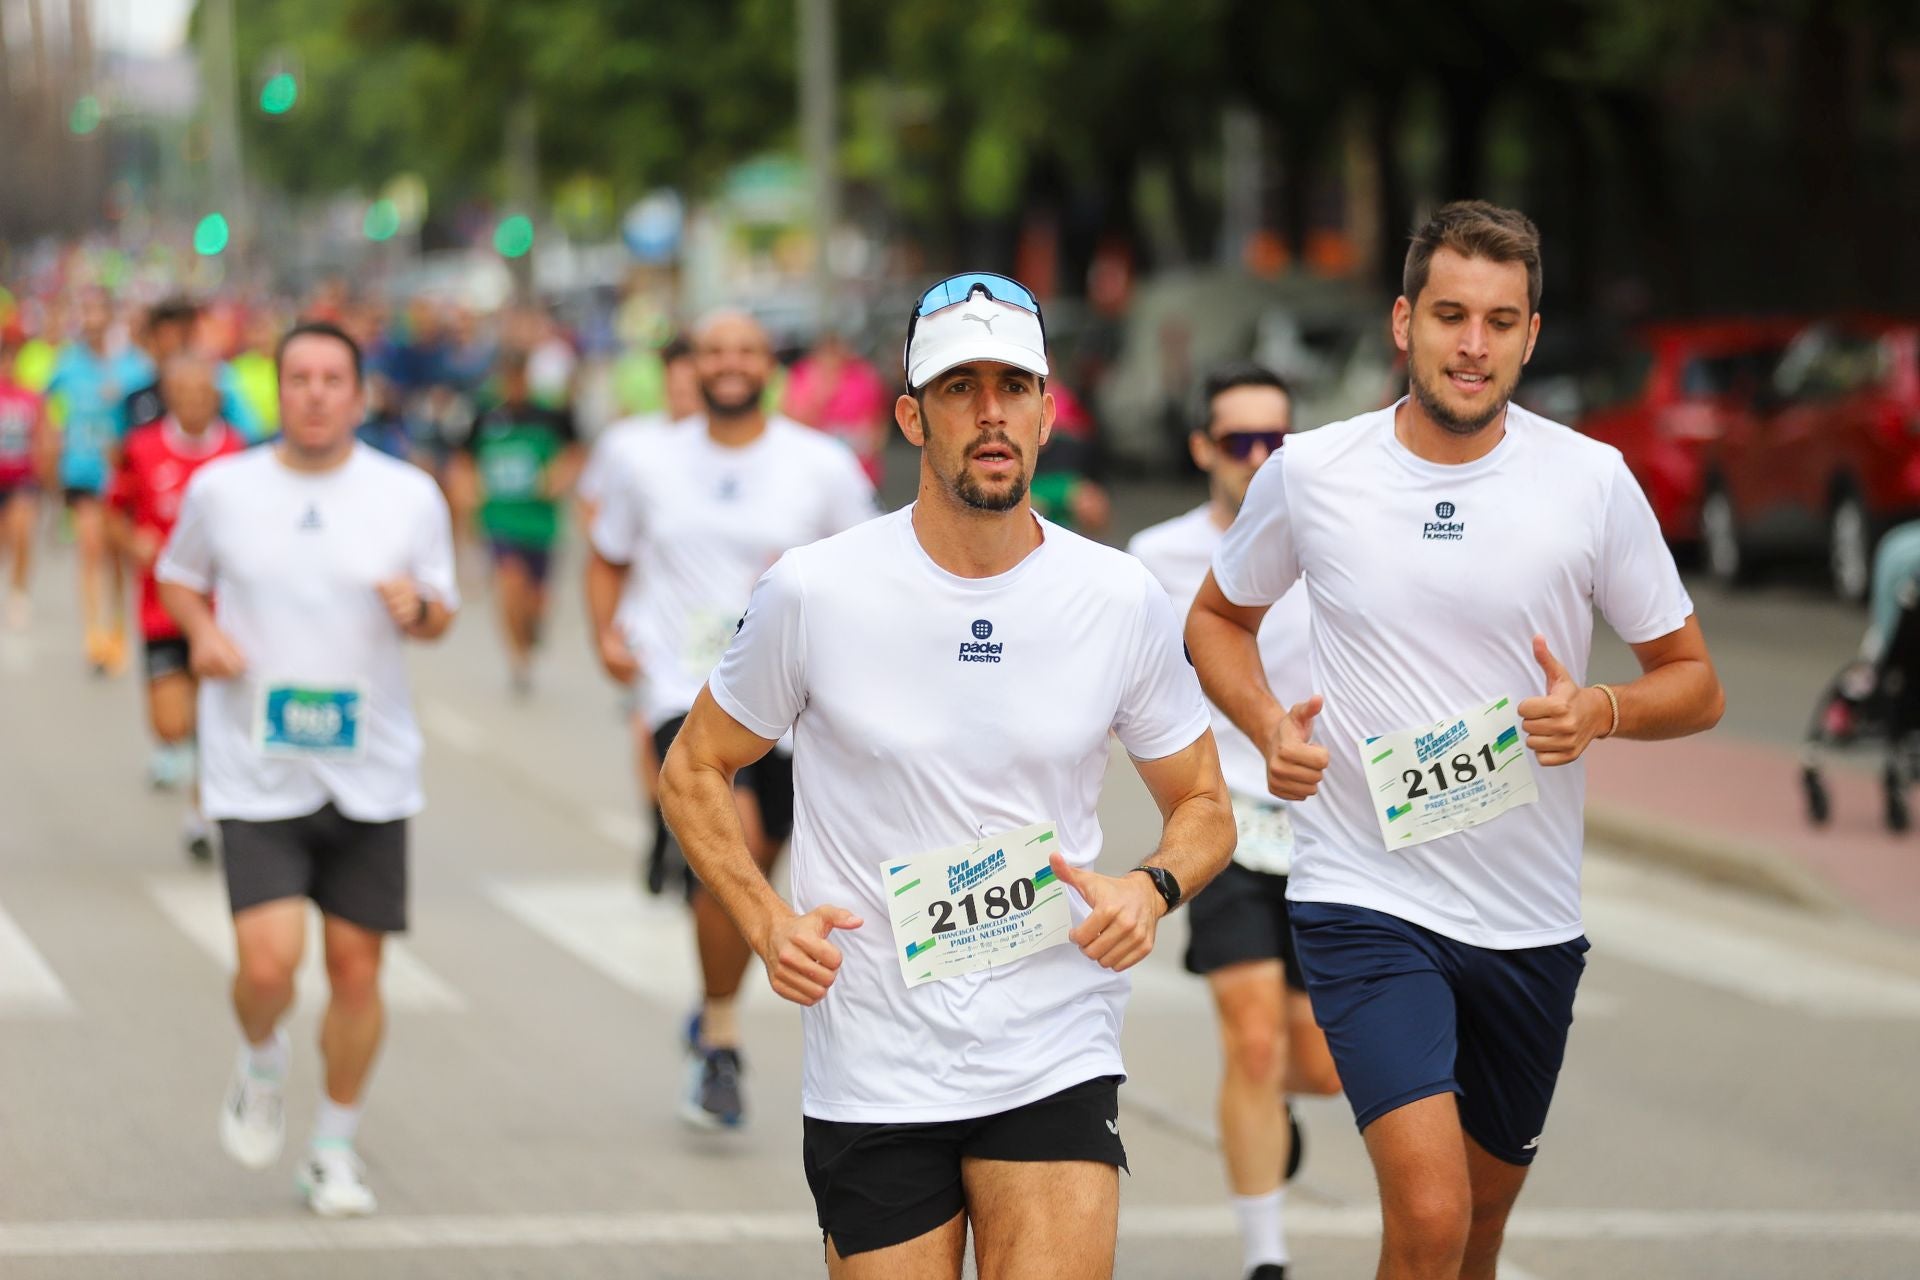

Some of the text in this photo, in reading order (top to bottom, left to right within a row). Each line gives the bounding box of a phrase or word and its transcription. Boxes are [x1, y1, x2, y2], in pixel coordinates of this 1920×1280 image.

[959, 654, 1001, 663] nuestro
[1417, 720, 1465, 757] CARRERA
[1402, 744, 1496, 799] 2181
[949, 849, 1004, 888] CARRERA
[951, 887, 961, 895] DE
[962, 857, 1006, 888] EMPRESAS
[928, 878, 1035, 934] 2180
[938, 928, 975, 940] FRANCISCO
[950, 936, 978, 947] PADEL
[980, 924, 1018, 939] NUESTRO
